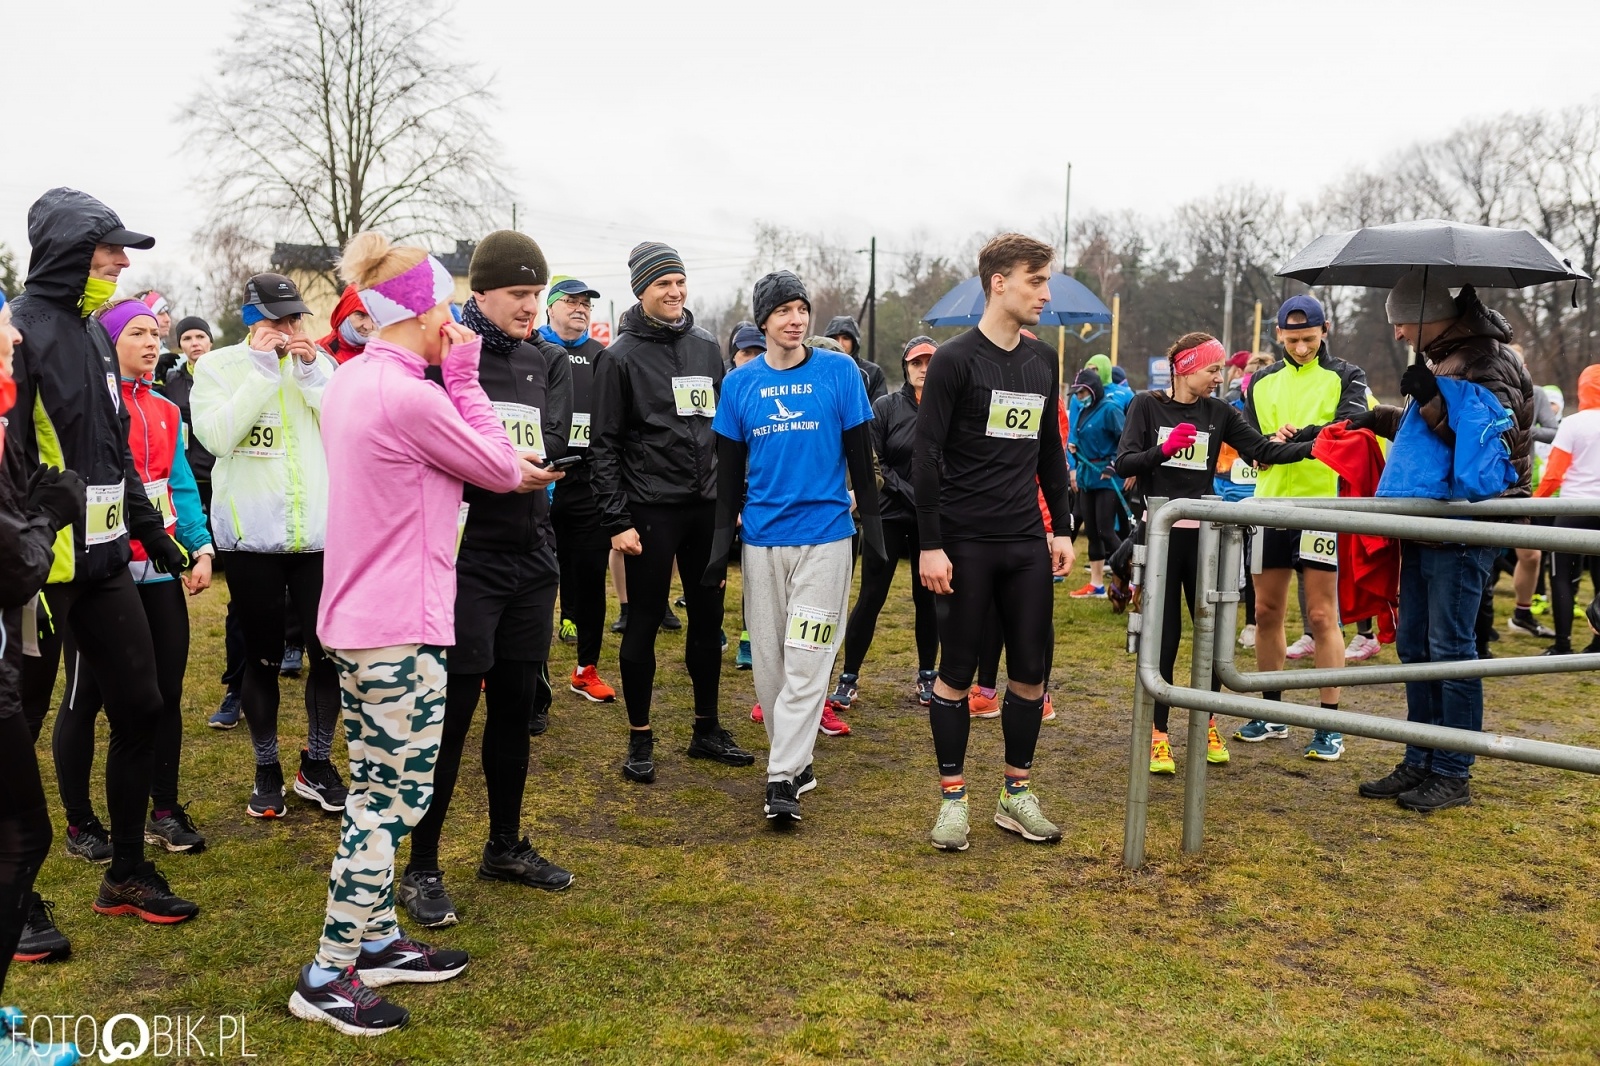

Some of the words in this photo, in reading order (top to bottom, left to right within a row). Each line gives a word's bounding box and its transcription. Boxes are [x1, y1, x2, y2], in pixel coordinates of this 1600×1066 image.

[690, 389, 707, 408] 60
[760, 385, 788, 398] WIELKI
[791, 383, 812, 395] REJS
[1005, 407, 1031, 430] 62
[249, 426, 273, 448] 59
[572, 424, 591, 440] 76
[752, 424, 771, 437] PRZEZ
[772, 422, 789, 433] CAŁE
[790, 420, 819, 431] MAZURY
[1313, 537, 1336, 556] 69
[799, 620, 832, 644] 110
